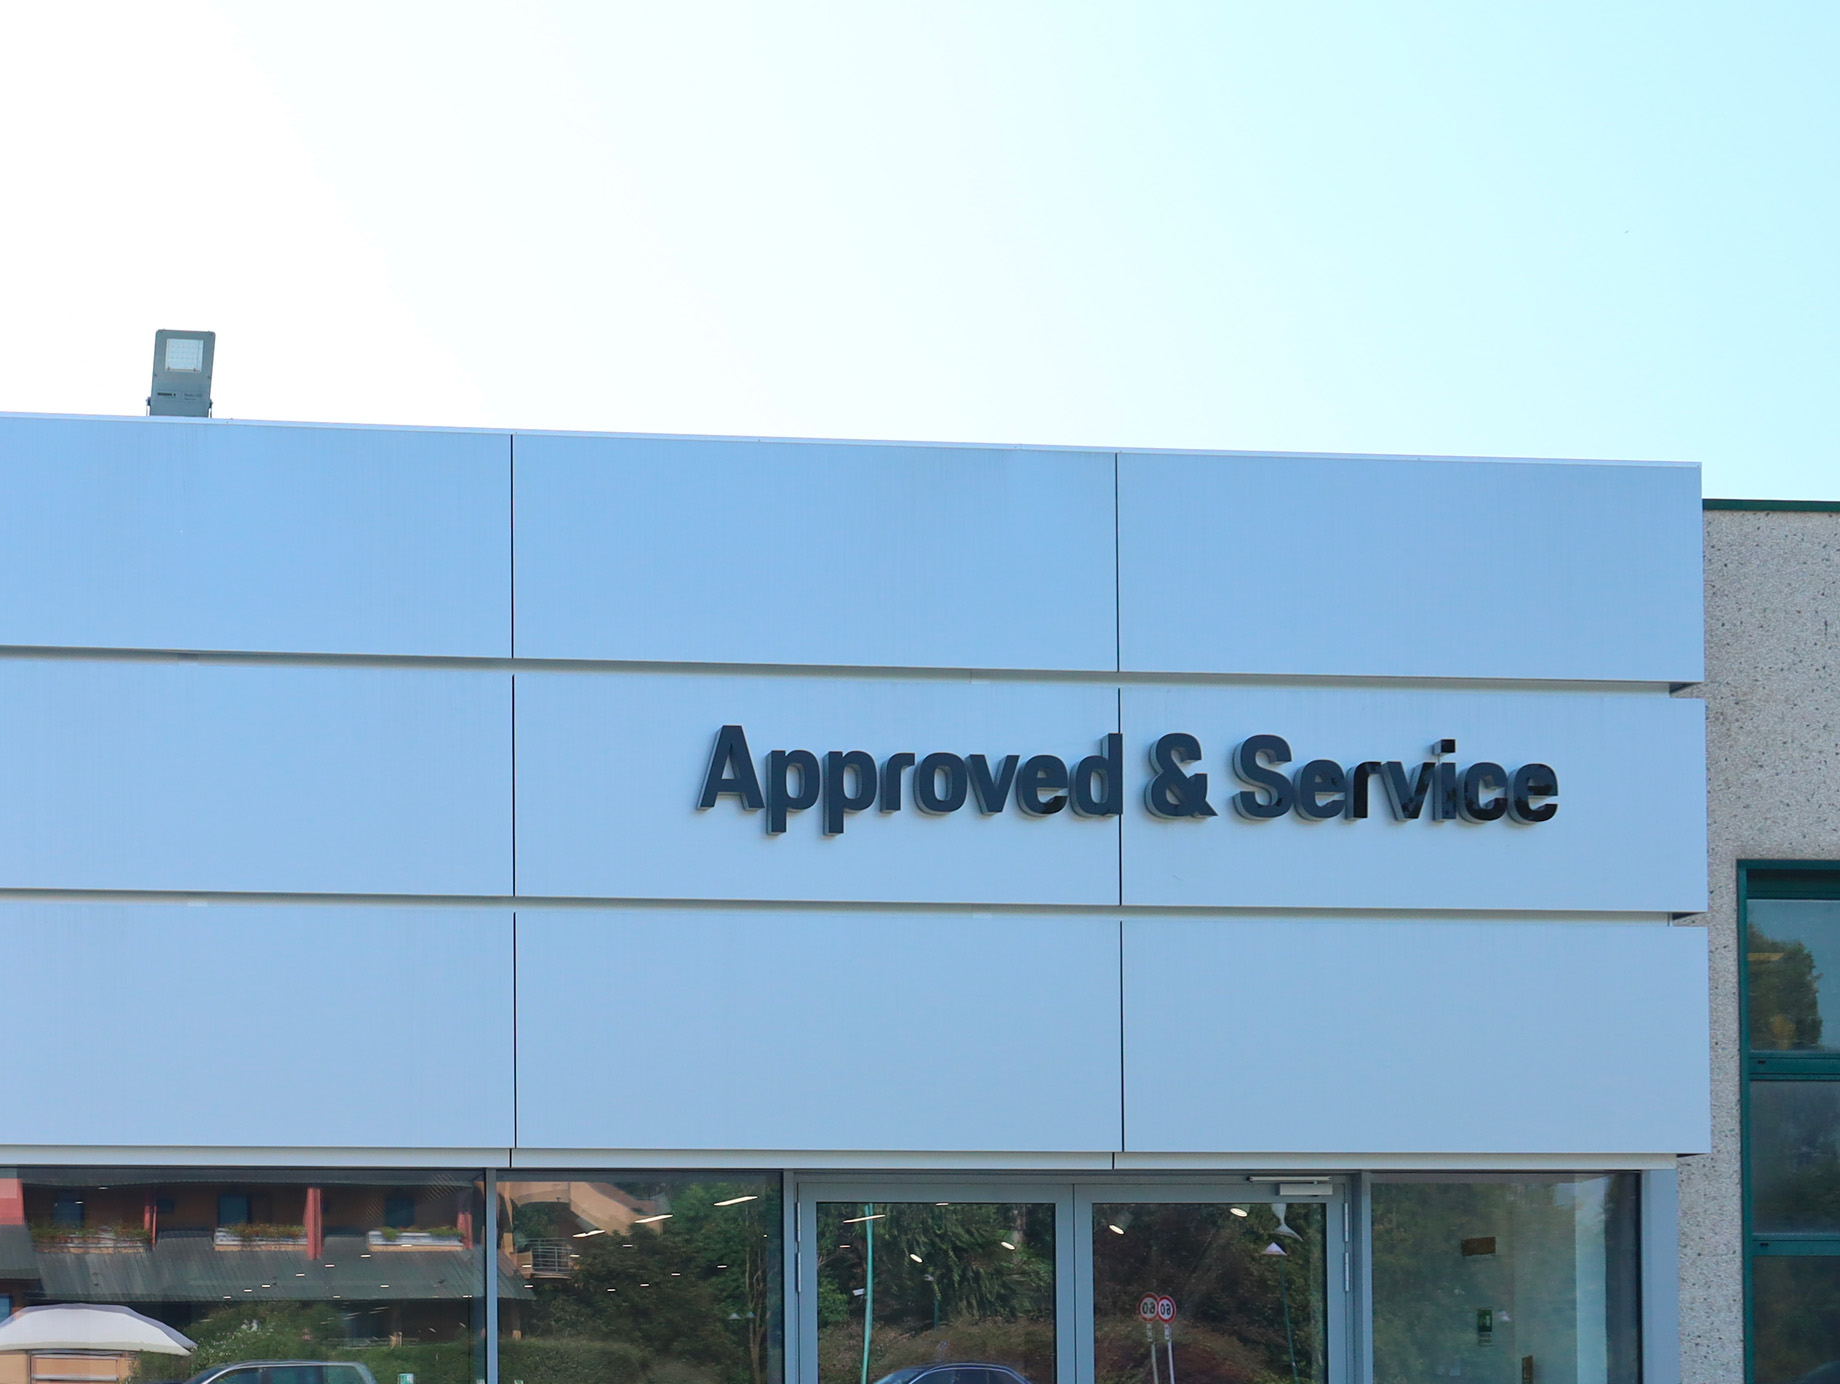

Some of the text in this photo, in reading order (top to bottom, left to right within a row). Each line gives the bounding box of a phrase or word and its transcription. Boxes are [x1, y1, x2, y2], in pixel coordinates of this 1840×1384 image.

[697, 724, 1559, 836] Approved & Service
